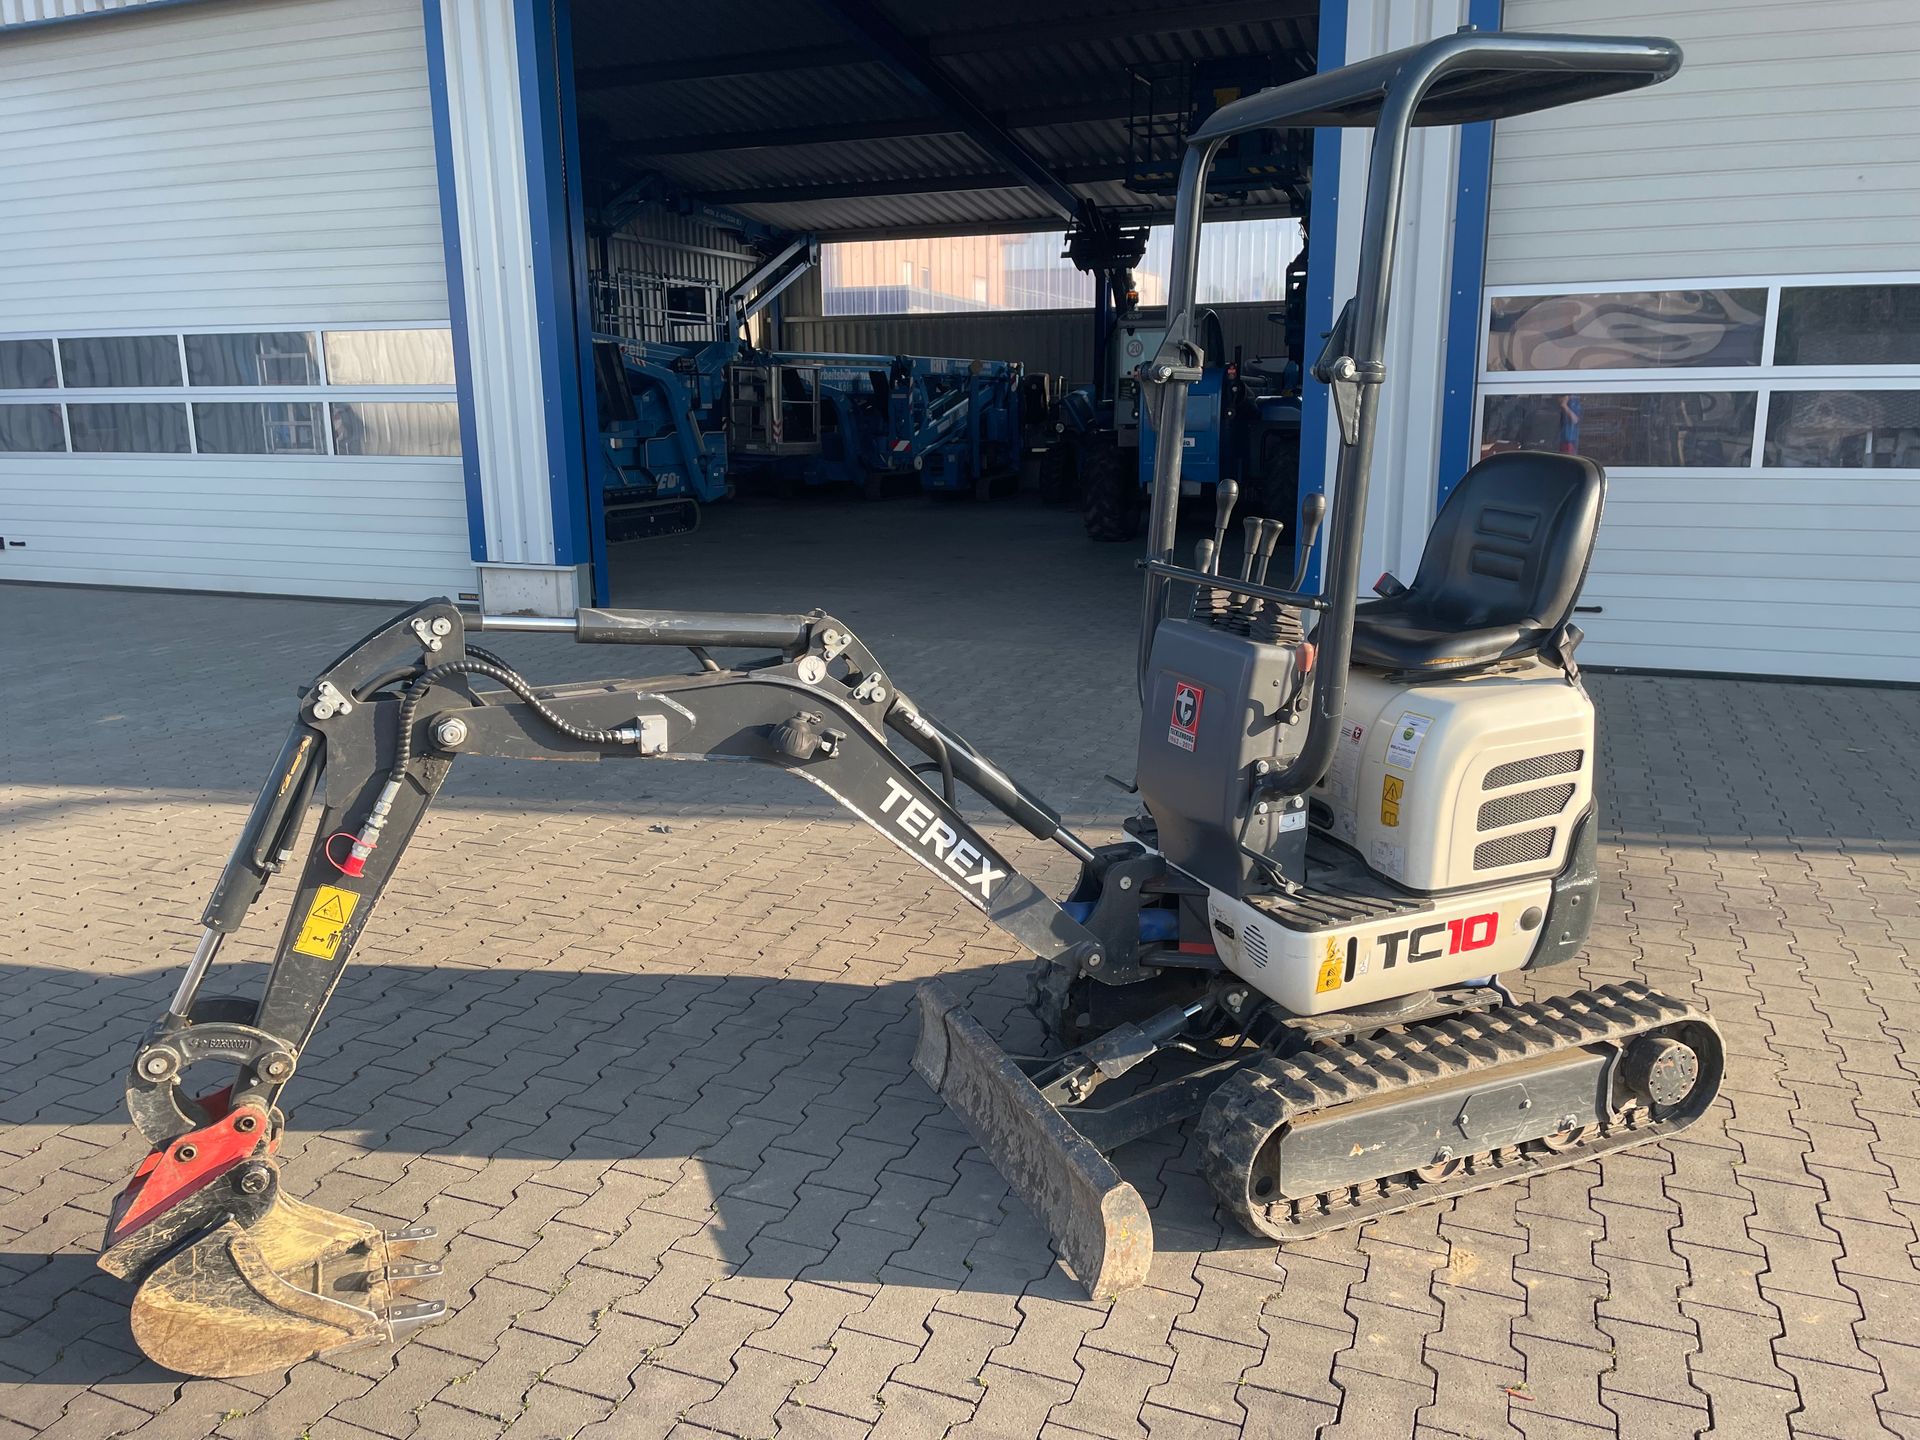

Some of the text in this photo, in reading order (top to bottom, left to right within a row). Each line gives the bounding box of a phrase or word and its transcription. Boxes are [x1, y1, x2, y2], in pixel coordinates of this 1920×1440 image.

[1130, 343, 1140, 354] 20
[878, 776, 1007, 900] TEREX
[1376, 911, 1499, 970] TC10
